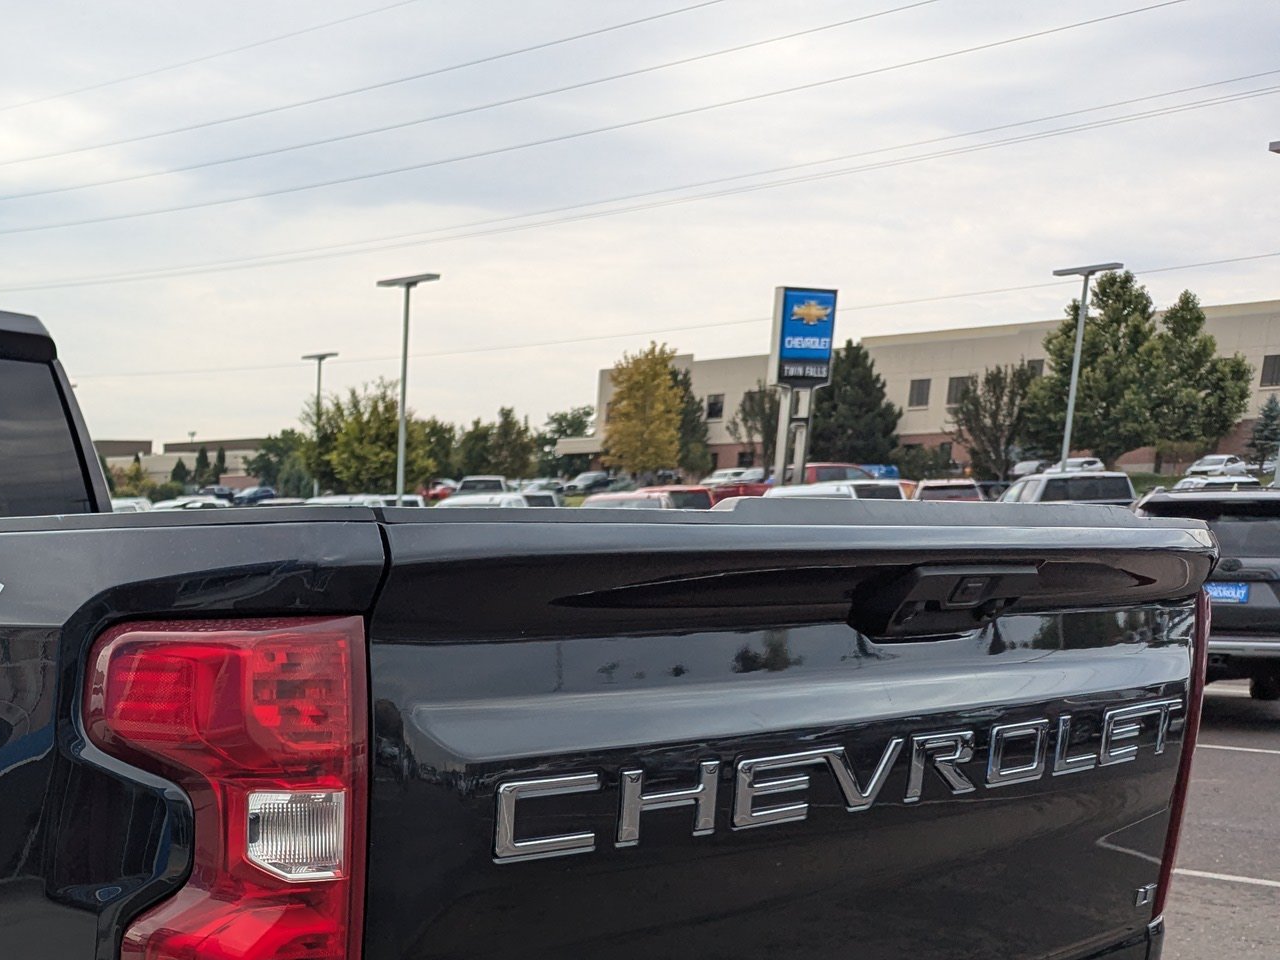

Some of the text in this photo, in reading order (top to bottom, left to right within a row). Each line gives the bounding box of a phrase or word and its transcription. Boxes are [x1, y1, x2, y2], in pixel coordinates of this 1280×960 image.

[784, 336, 830, 349] CHEVROLET
[783, 365, 828, 378] TWIN FALLS
[494, 698, 1182, 864] CHEVROLET
